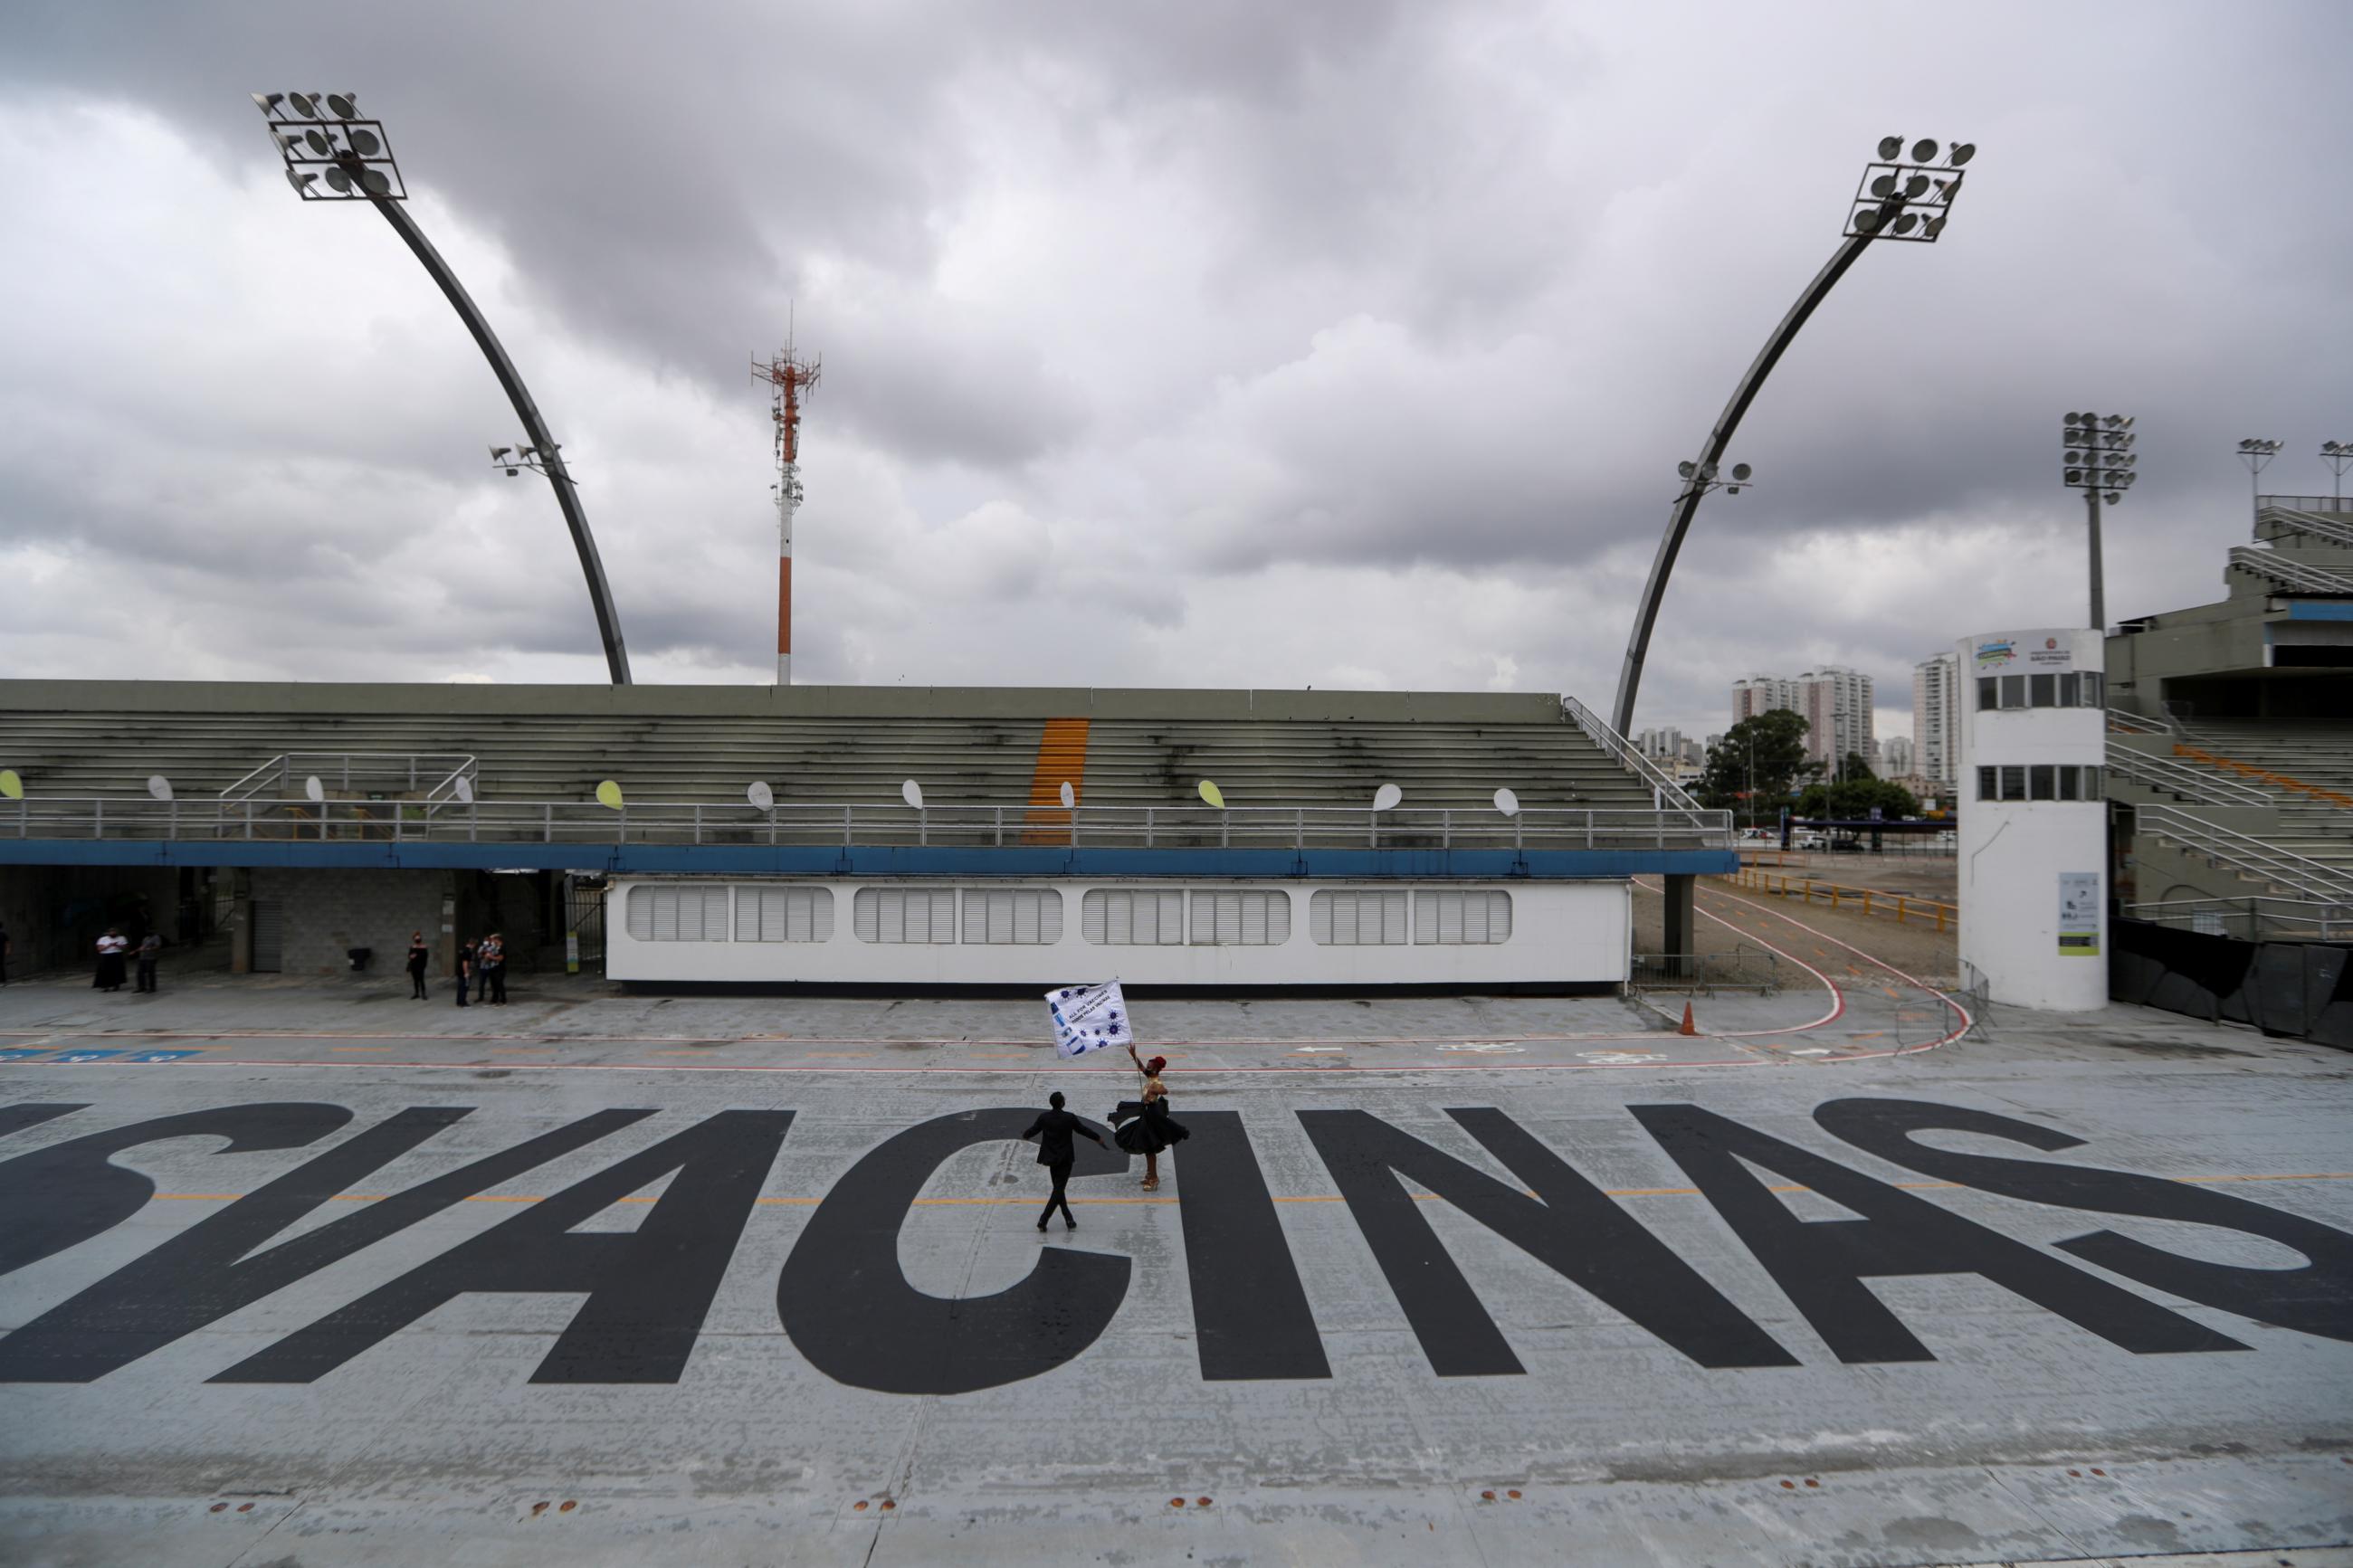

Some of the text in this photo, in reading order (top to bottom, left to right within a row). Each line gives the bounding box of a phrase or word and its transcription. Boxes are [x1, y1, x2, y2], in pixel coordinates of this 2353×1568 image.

[1069, 989, 1108, 1019] ALL FOR VACCINES
[0, 1097, 2353, 1396] VACINAS
